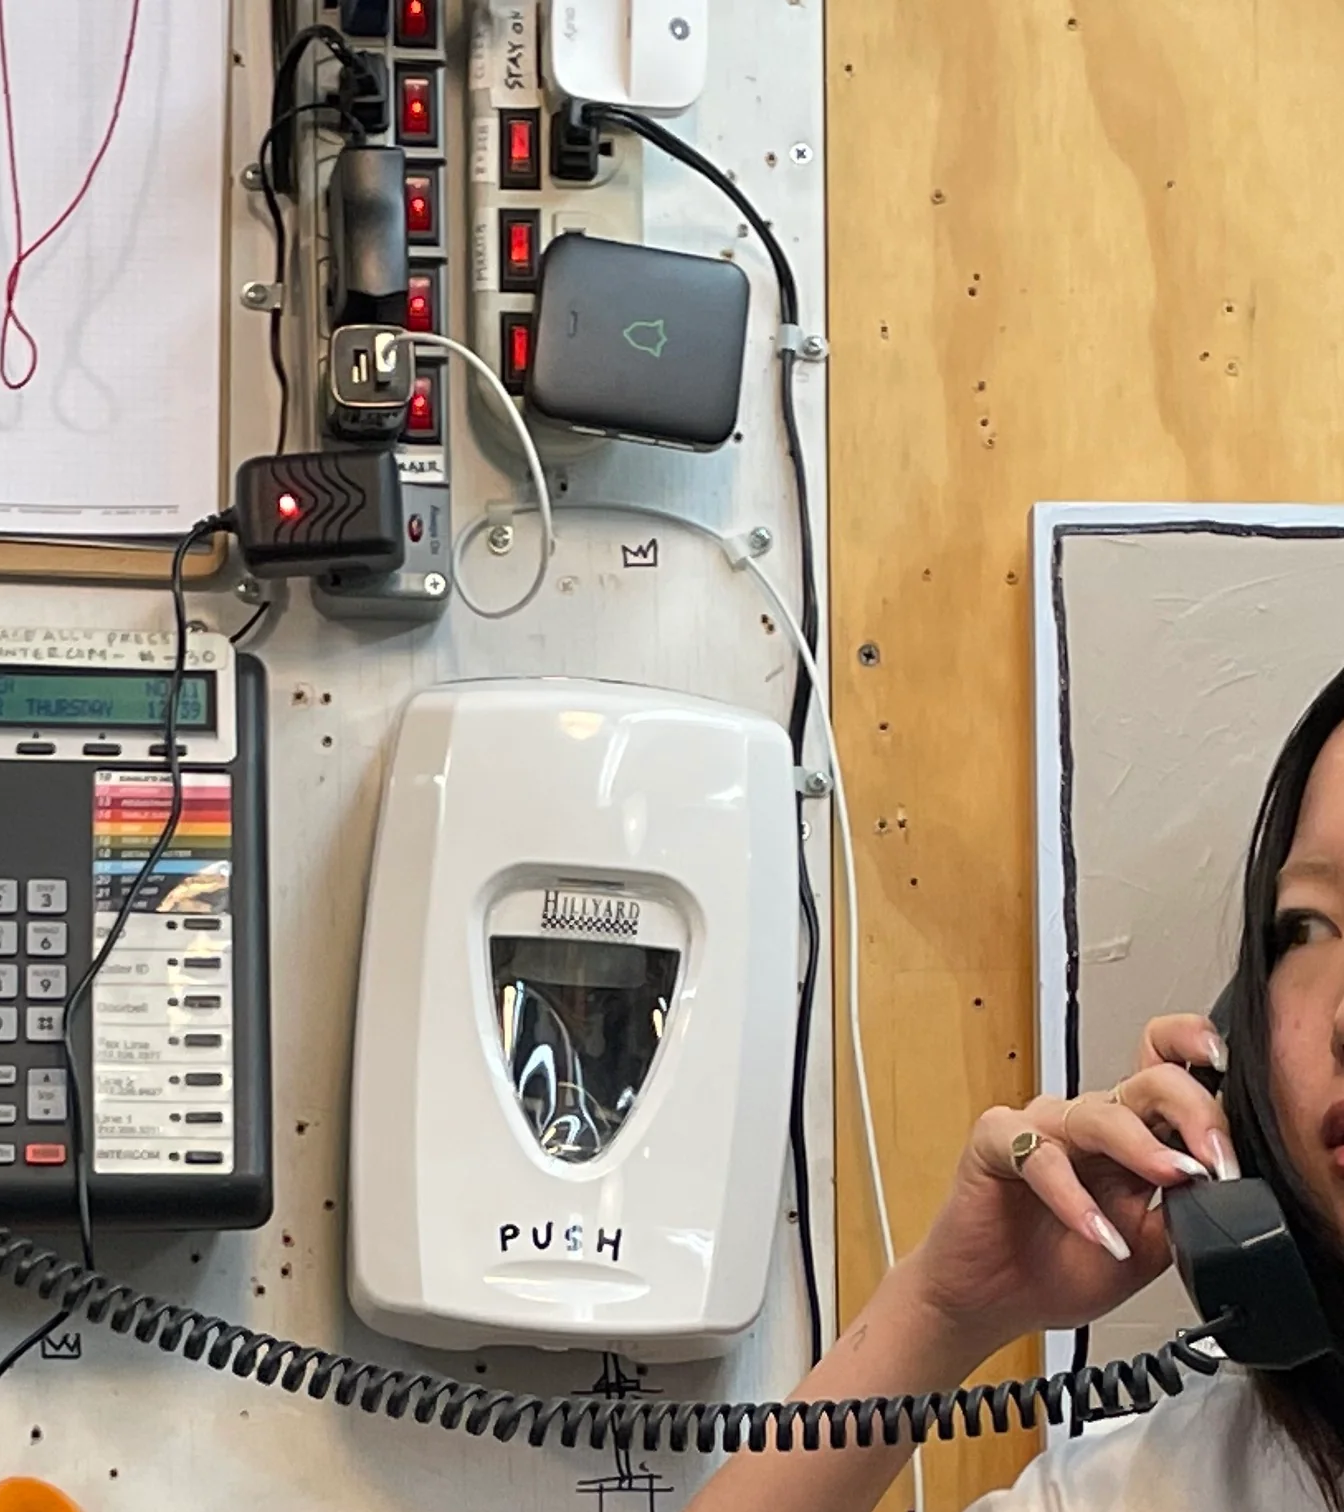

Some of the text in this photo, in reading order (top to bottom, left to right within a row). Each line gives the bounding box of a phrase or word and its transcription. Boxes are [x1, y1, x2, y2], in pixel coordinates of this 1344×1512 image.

[504, 10, 525, 90] STAY ON
[25, 700, 114, 718] THURSDAY
[41, 893, 52, 907] 3
[542, 889, 641, 919] HILLYARD
[40, 937, 52, 950] 6
[40, 978, 51, 992] 9
[499, 1223, 623, 1262] PUSH
